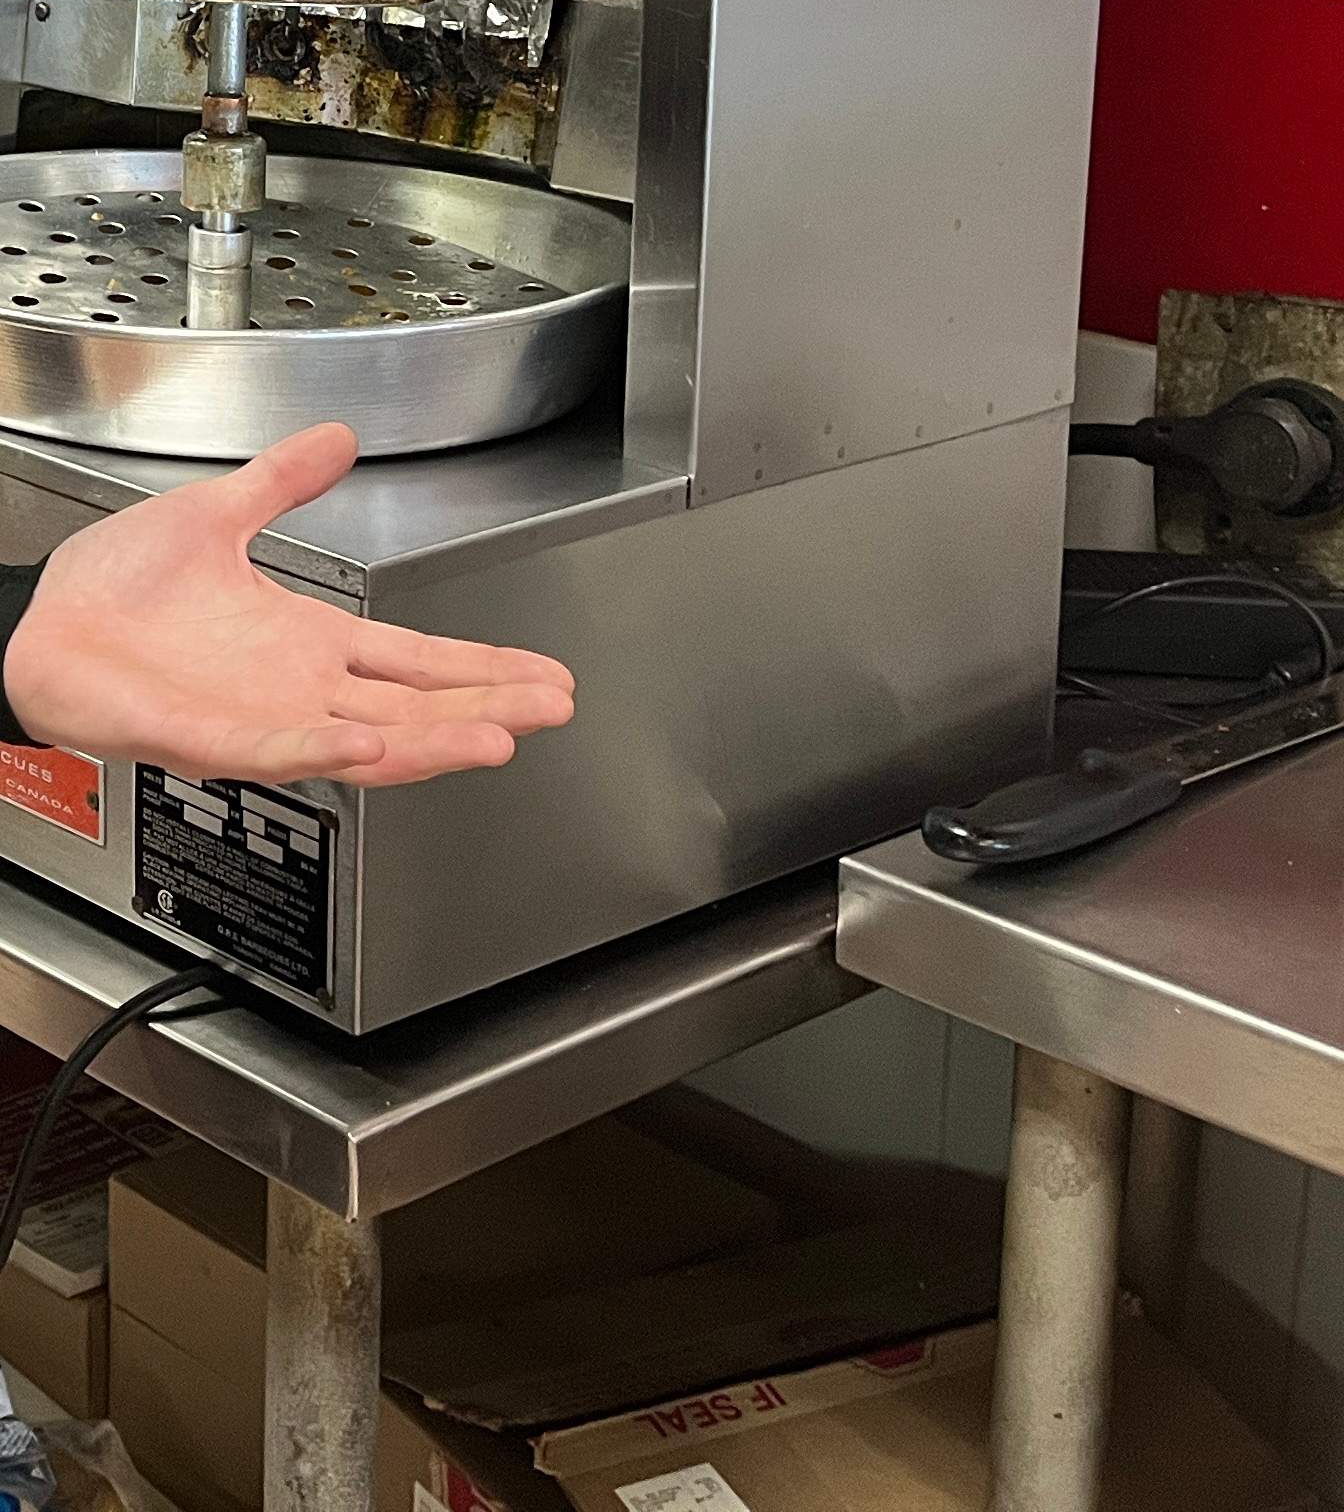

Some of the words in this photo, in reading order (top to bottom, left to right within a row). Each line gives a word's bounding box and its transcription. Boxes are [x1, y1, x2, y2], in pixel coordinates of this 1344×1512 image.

[5, 778, 75, 816] CANADA
[631, 1393, 744, 1439] SEAL
[750, 1381, 787, 1413] IF
